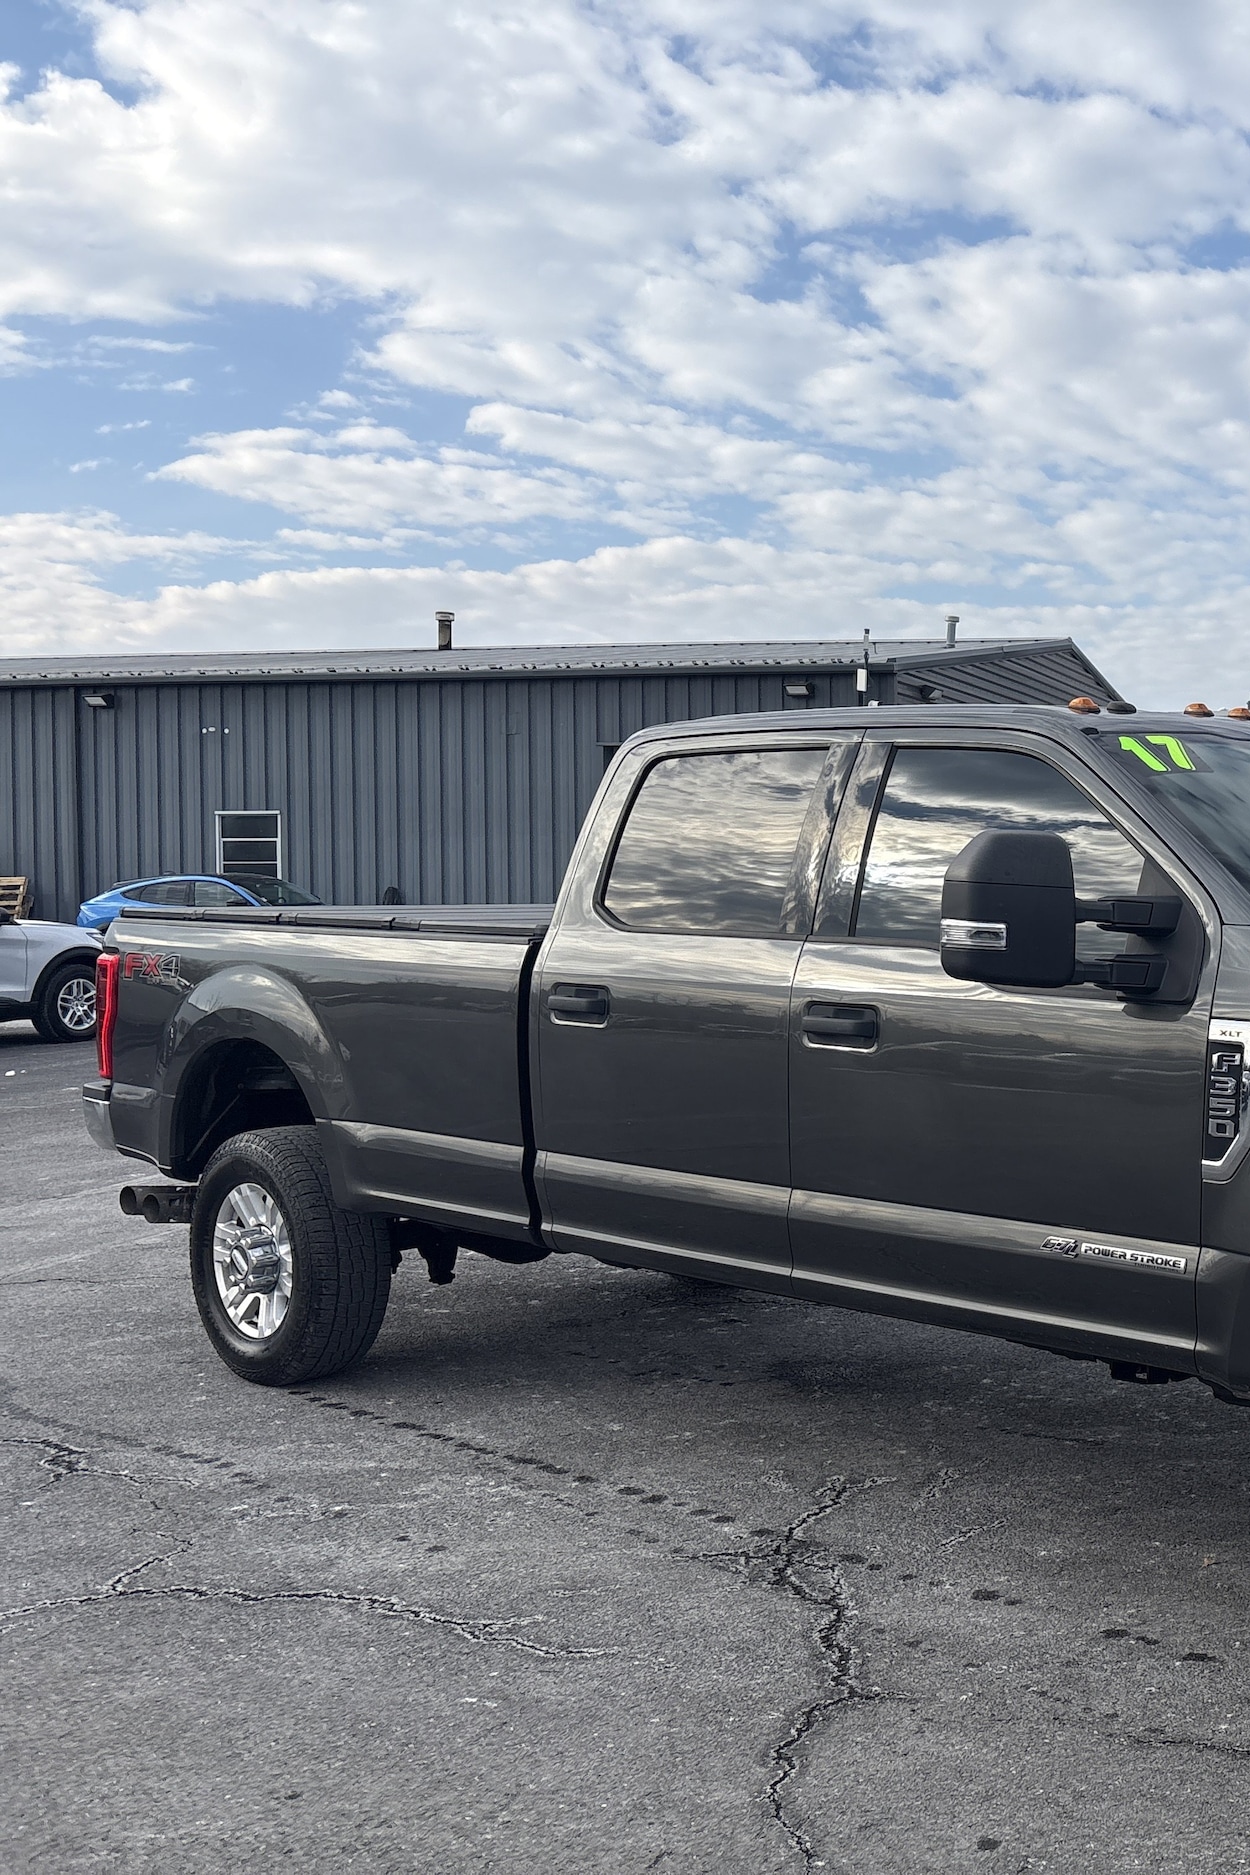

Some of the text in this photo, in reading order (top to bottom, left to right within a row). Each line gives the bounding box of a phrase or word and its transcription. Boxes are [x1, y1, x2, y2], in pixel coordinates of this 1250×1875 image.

[1118, 736, 1196, 771] 17
[123, 951, 181, 980] FX4
[1219, 1030, 1243, 1038] XLT
[1208, 1052, 1241, 1138] F350
[1084, 1245, 1127, 1260] POWER
[1130, 1253, 1181, 1269] STROKE
